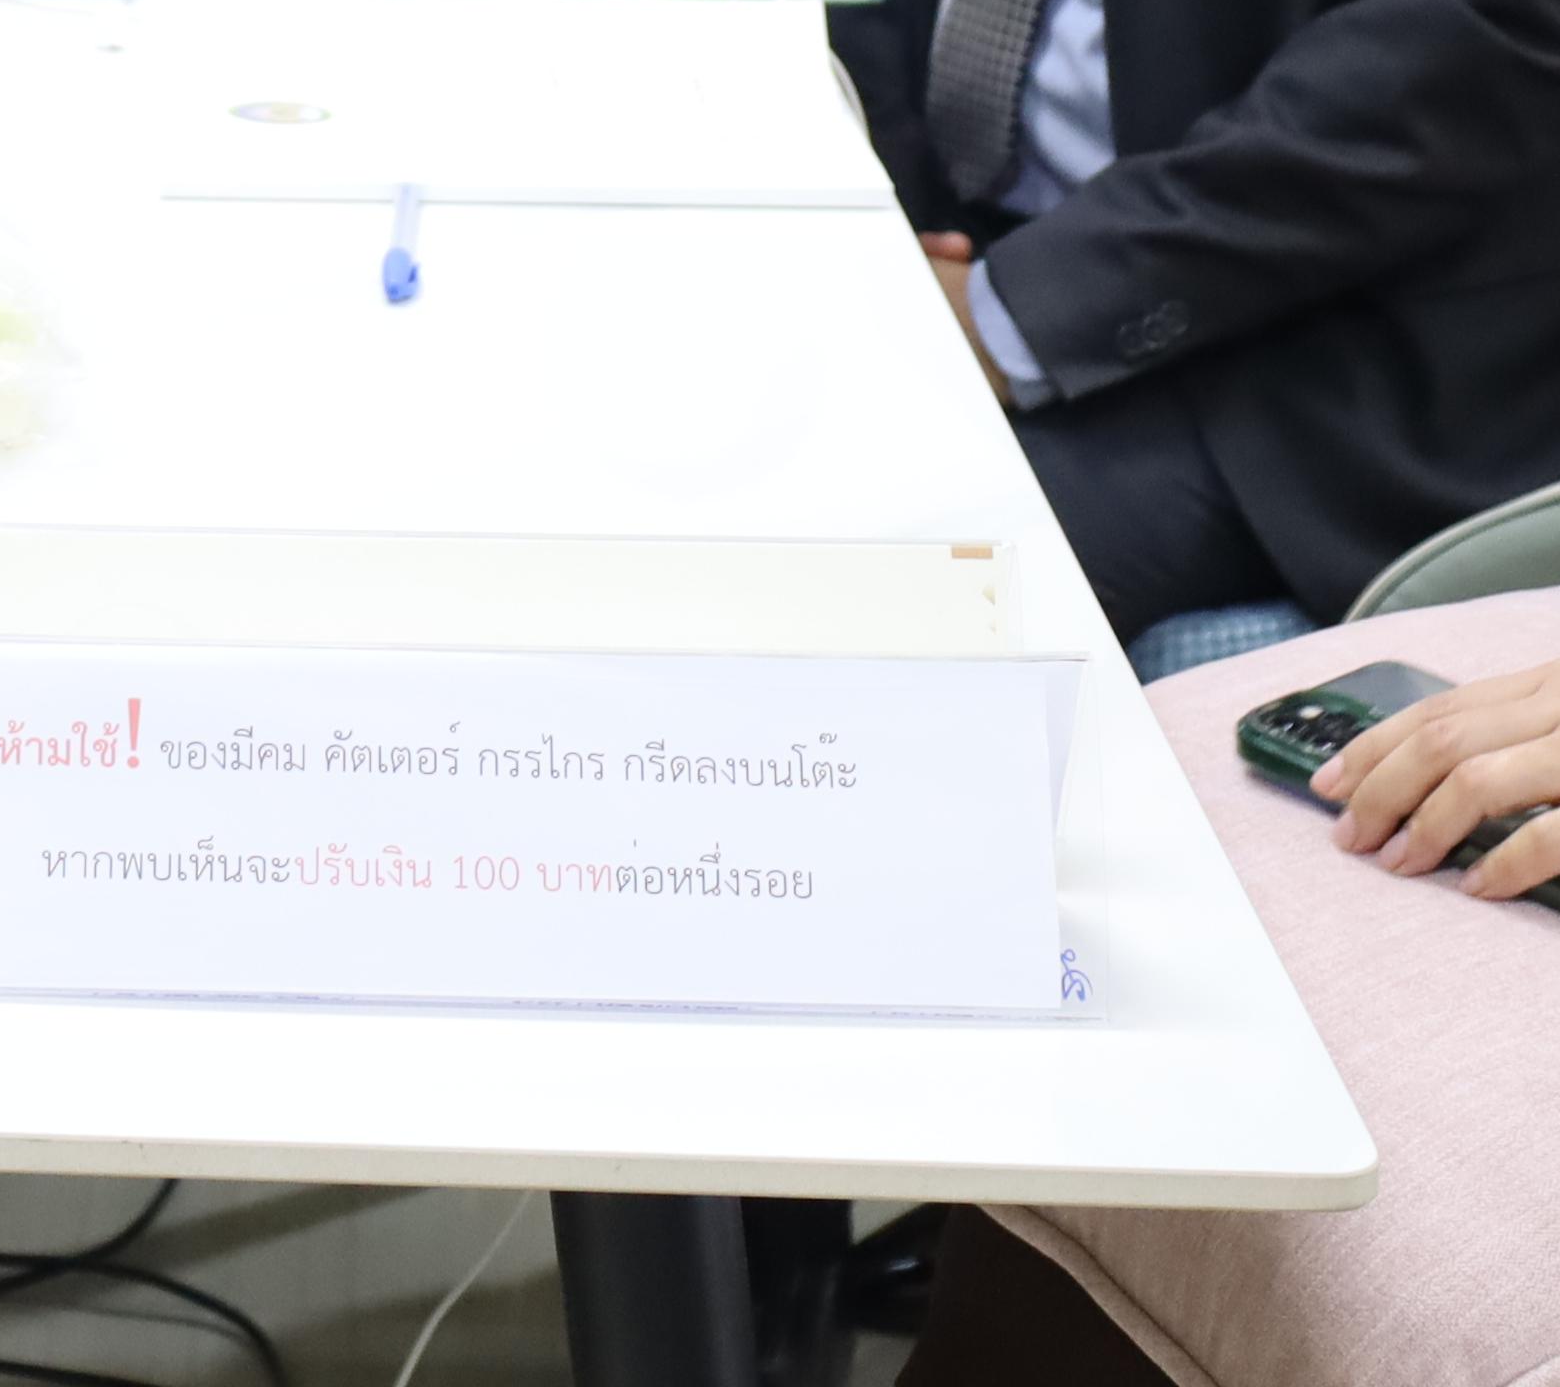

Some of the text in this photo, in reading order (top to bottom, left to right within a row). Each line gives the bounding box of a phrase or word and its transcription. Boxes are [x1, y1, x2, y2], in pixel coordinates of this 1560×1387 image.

[160, 726, 306, 771] ของมีคม
[324, 722, 461, 775] คัตเตอร์
[478, 733, 605, 780] กรรไกร
[624, 731, 857, 788] กรีดลงบนโต๊ะ
[41, 835, 813, 899] หากพบเห็นจะปรับเงิน 100 บาทต่อหนึ่งรอย
